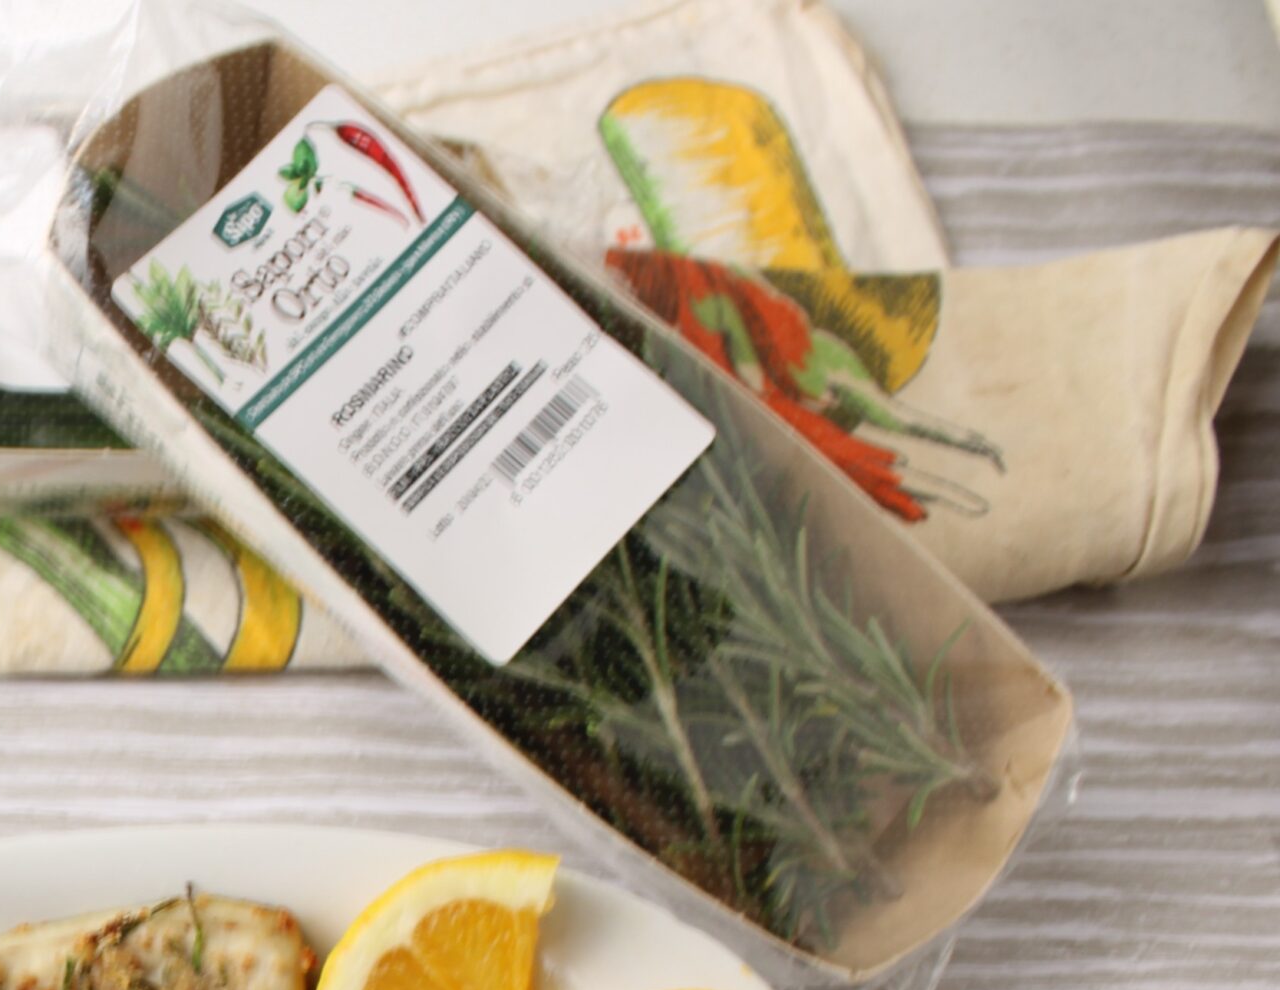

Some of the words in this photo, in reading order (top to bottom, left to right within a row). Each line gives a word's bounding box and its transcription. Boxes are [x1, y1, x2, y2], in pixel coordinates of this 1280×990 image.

[230, 211, 331, 305] Sapori
[268, 250, 352, 326] Orto
[329, 342, 416, 429] ROSMARINO
